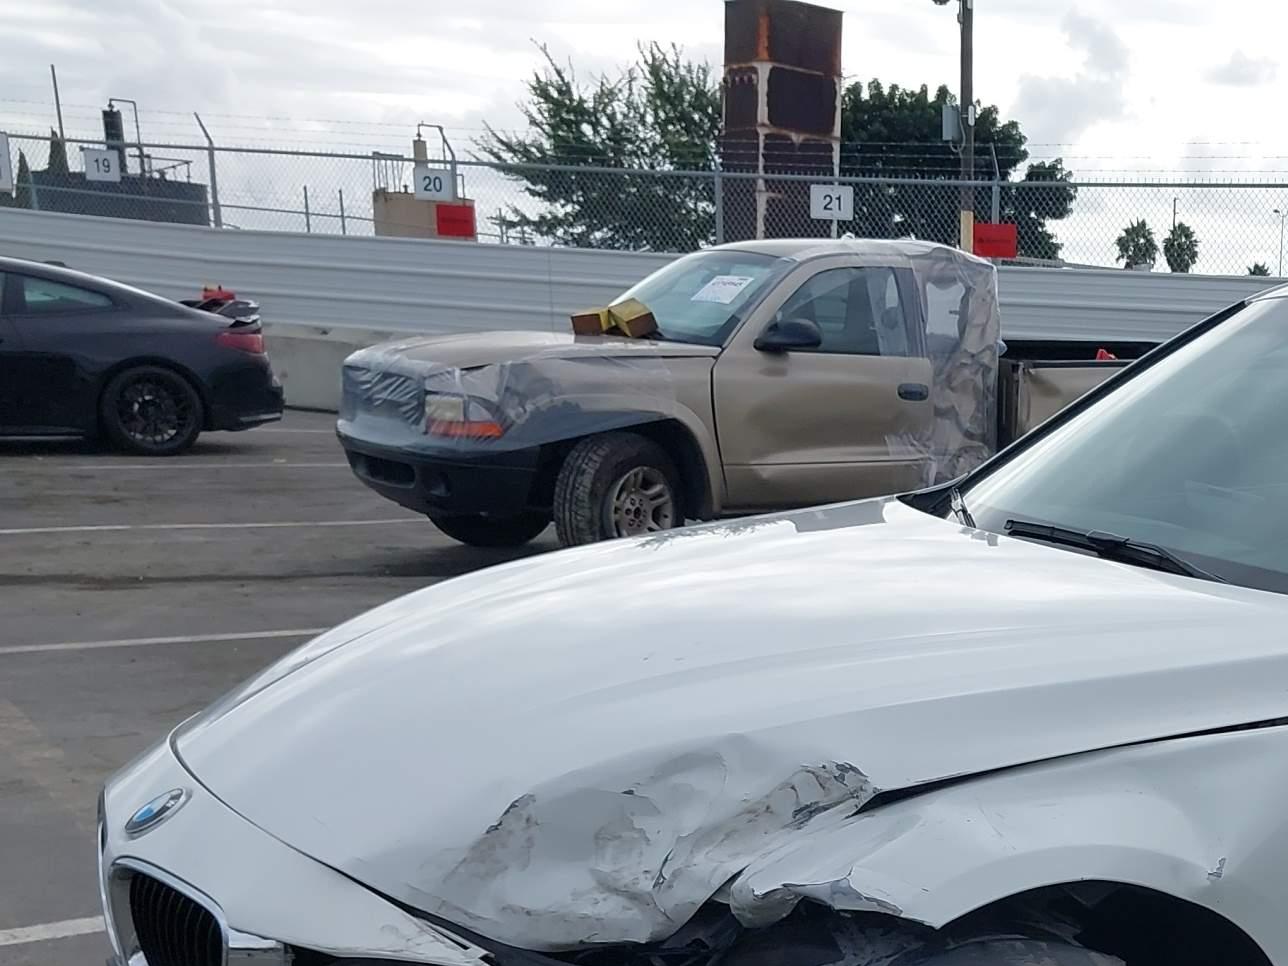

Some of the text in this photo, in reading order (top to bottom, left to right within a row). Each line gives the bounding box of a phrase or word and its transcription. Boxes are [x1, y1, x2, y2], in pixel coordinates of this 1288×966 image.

[93, 158, 112, 174] 19
[423, 175, 443, 193] 20
[823, 194, 842, 211] 21
